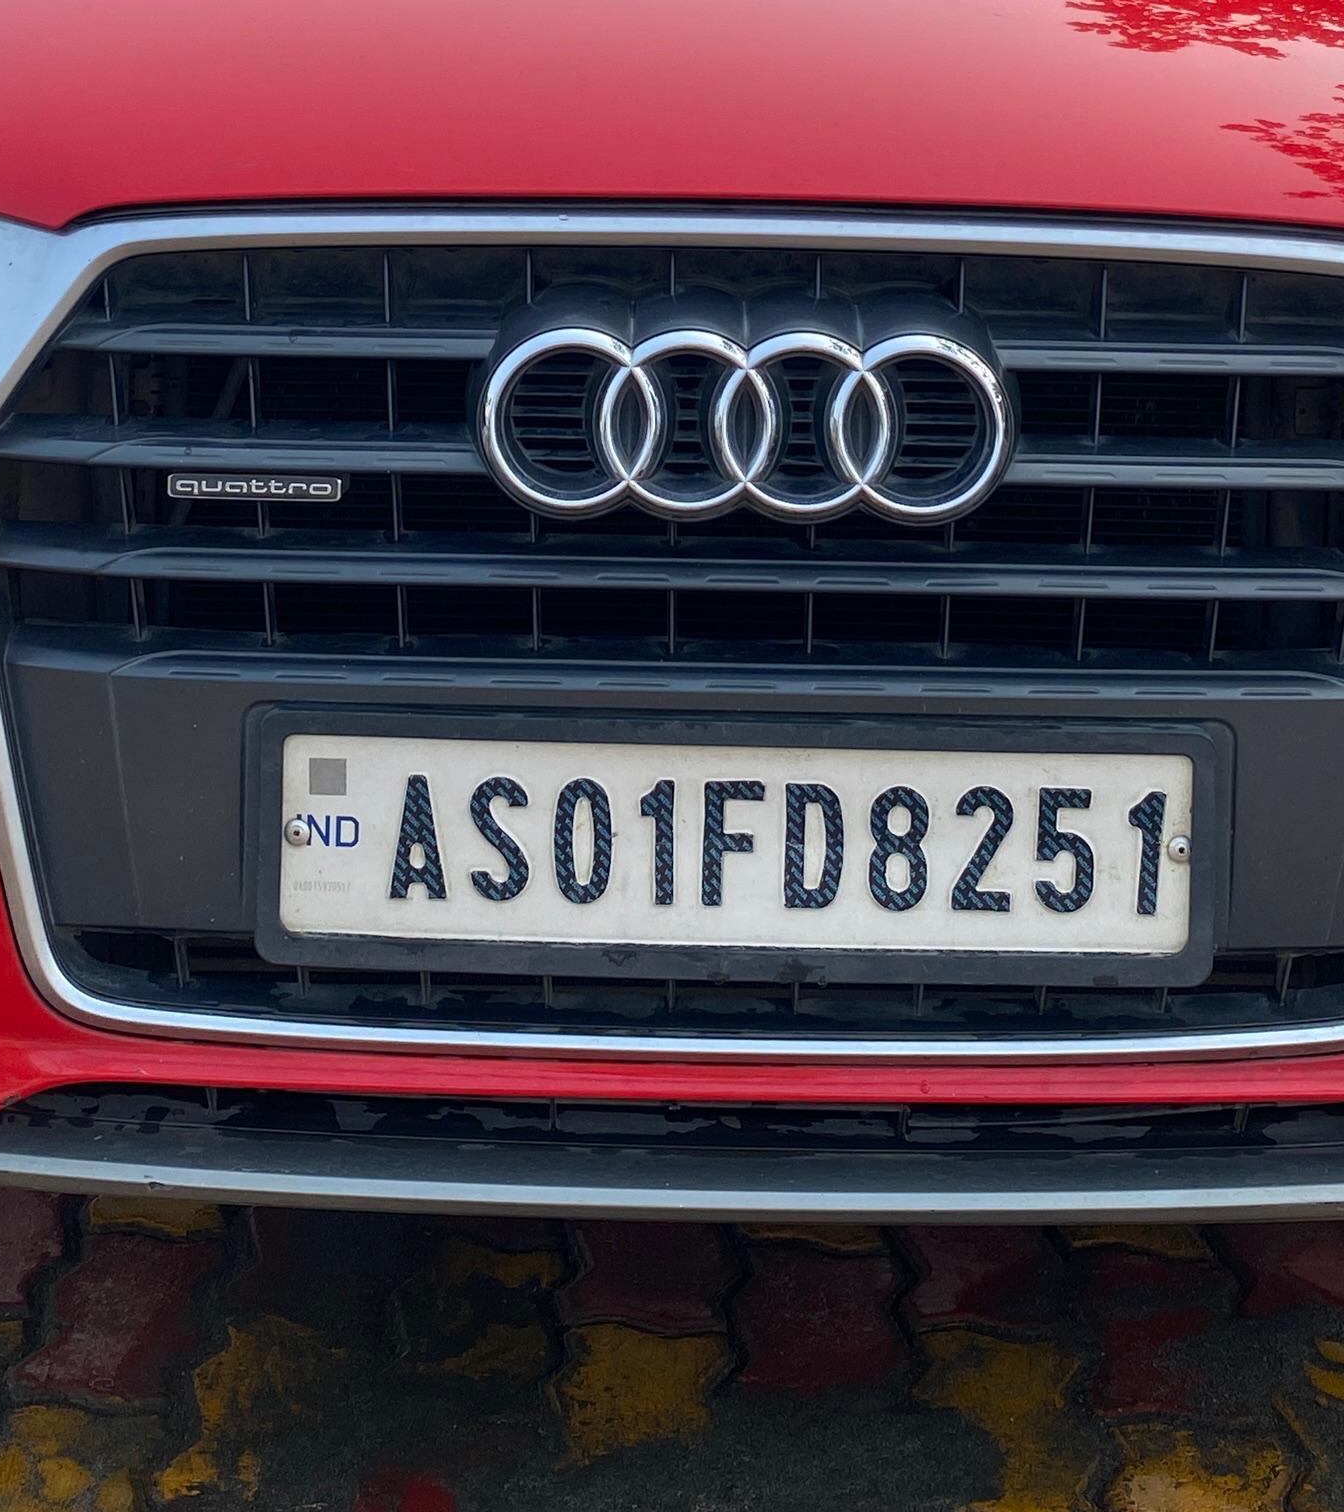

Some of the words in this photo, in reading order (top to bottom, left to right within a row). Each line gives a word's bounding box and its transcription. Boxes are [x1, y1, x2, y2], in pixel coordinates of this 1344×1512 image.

[174, 479, 333, 496] quattro
[297, 814, 360, 847] ND
[388, 774, 1168, 916] AS01FD8251
